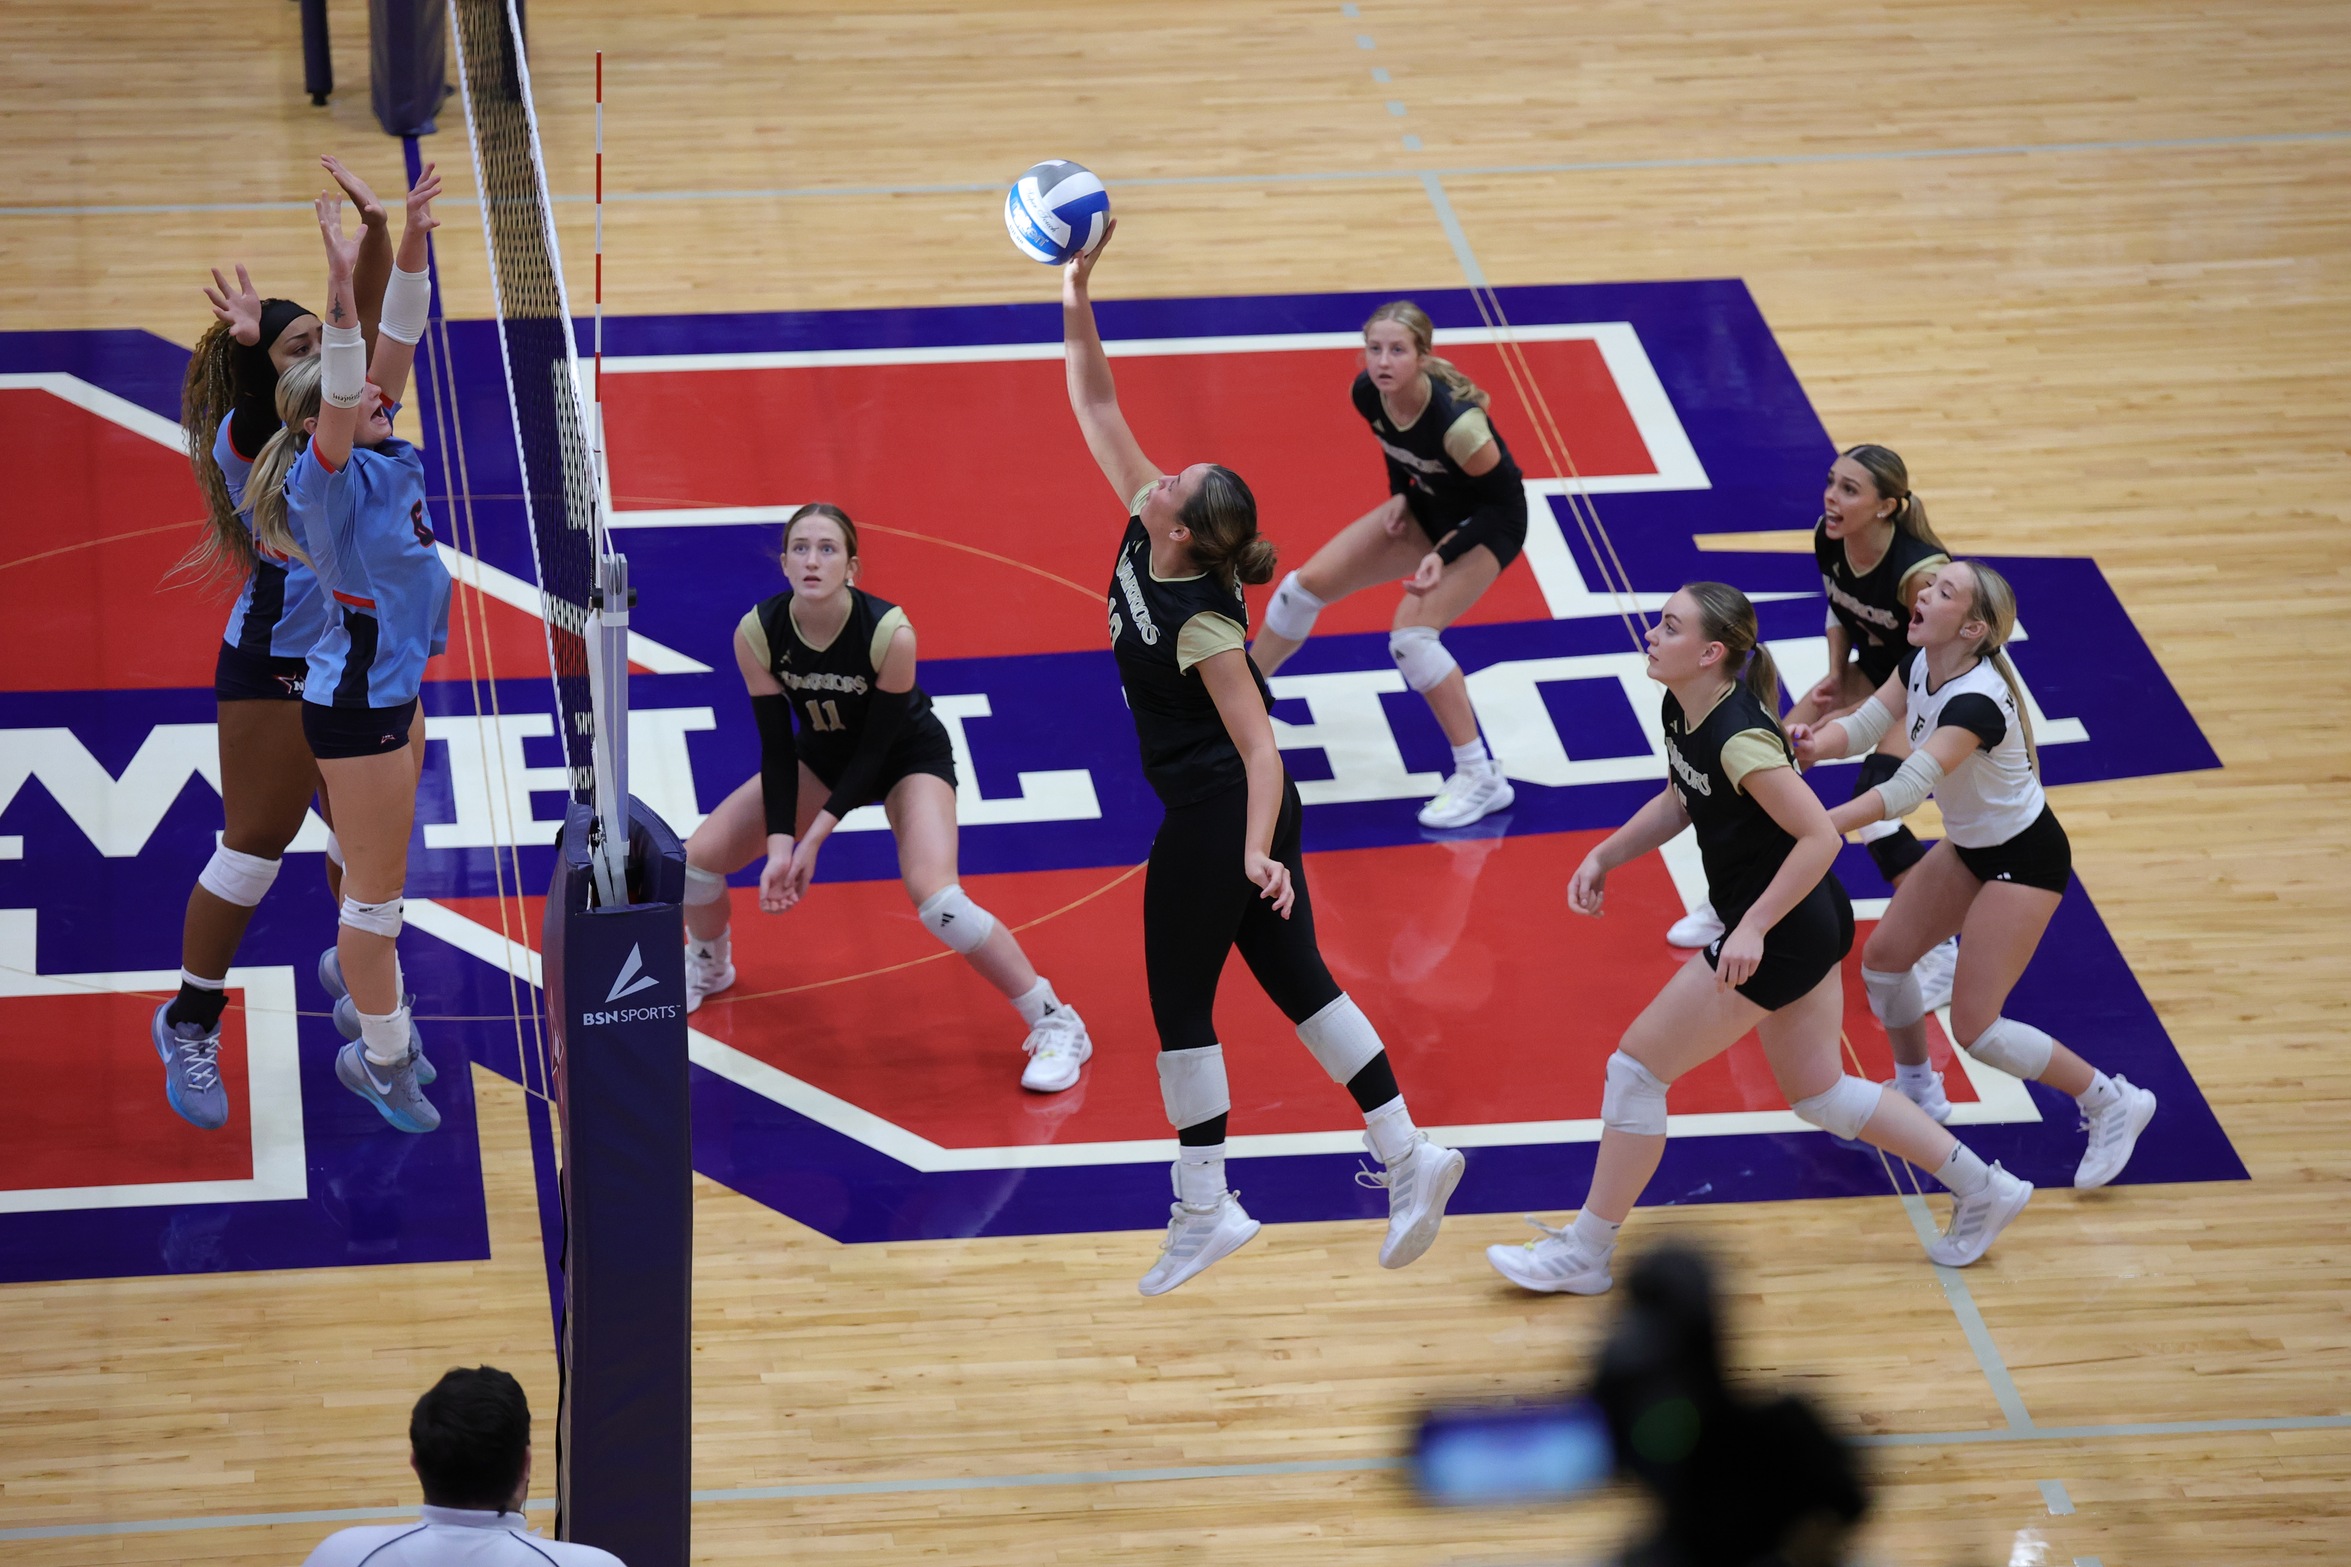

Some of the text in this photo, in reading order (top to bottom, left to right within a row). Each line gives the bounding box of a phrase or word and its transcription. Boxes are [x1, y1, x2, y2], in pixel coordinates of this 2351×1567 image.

[804, 699, 847, 732] 11
[583, 1005, 677, 1026] BSN SPORTS
